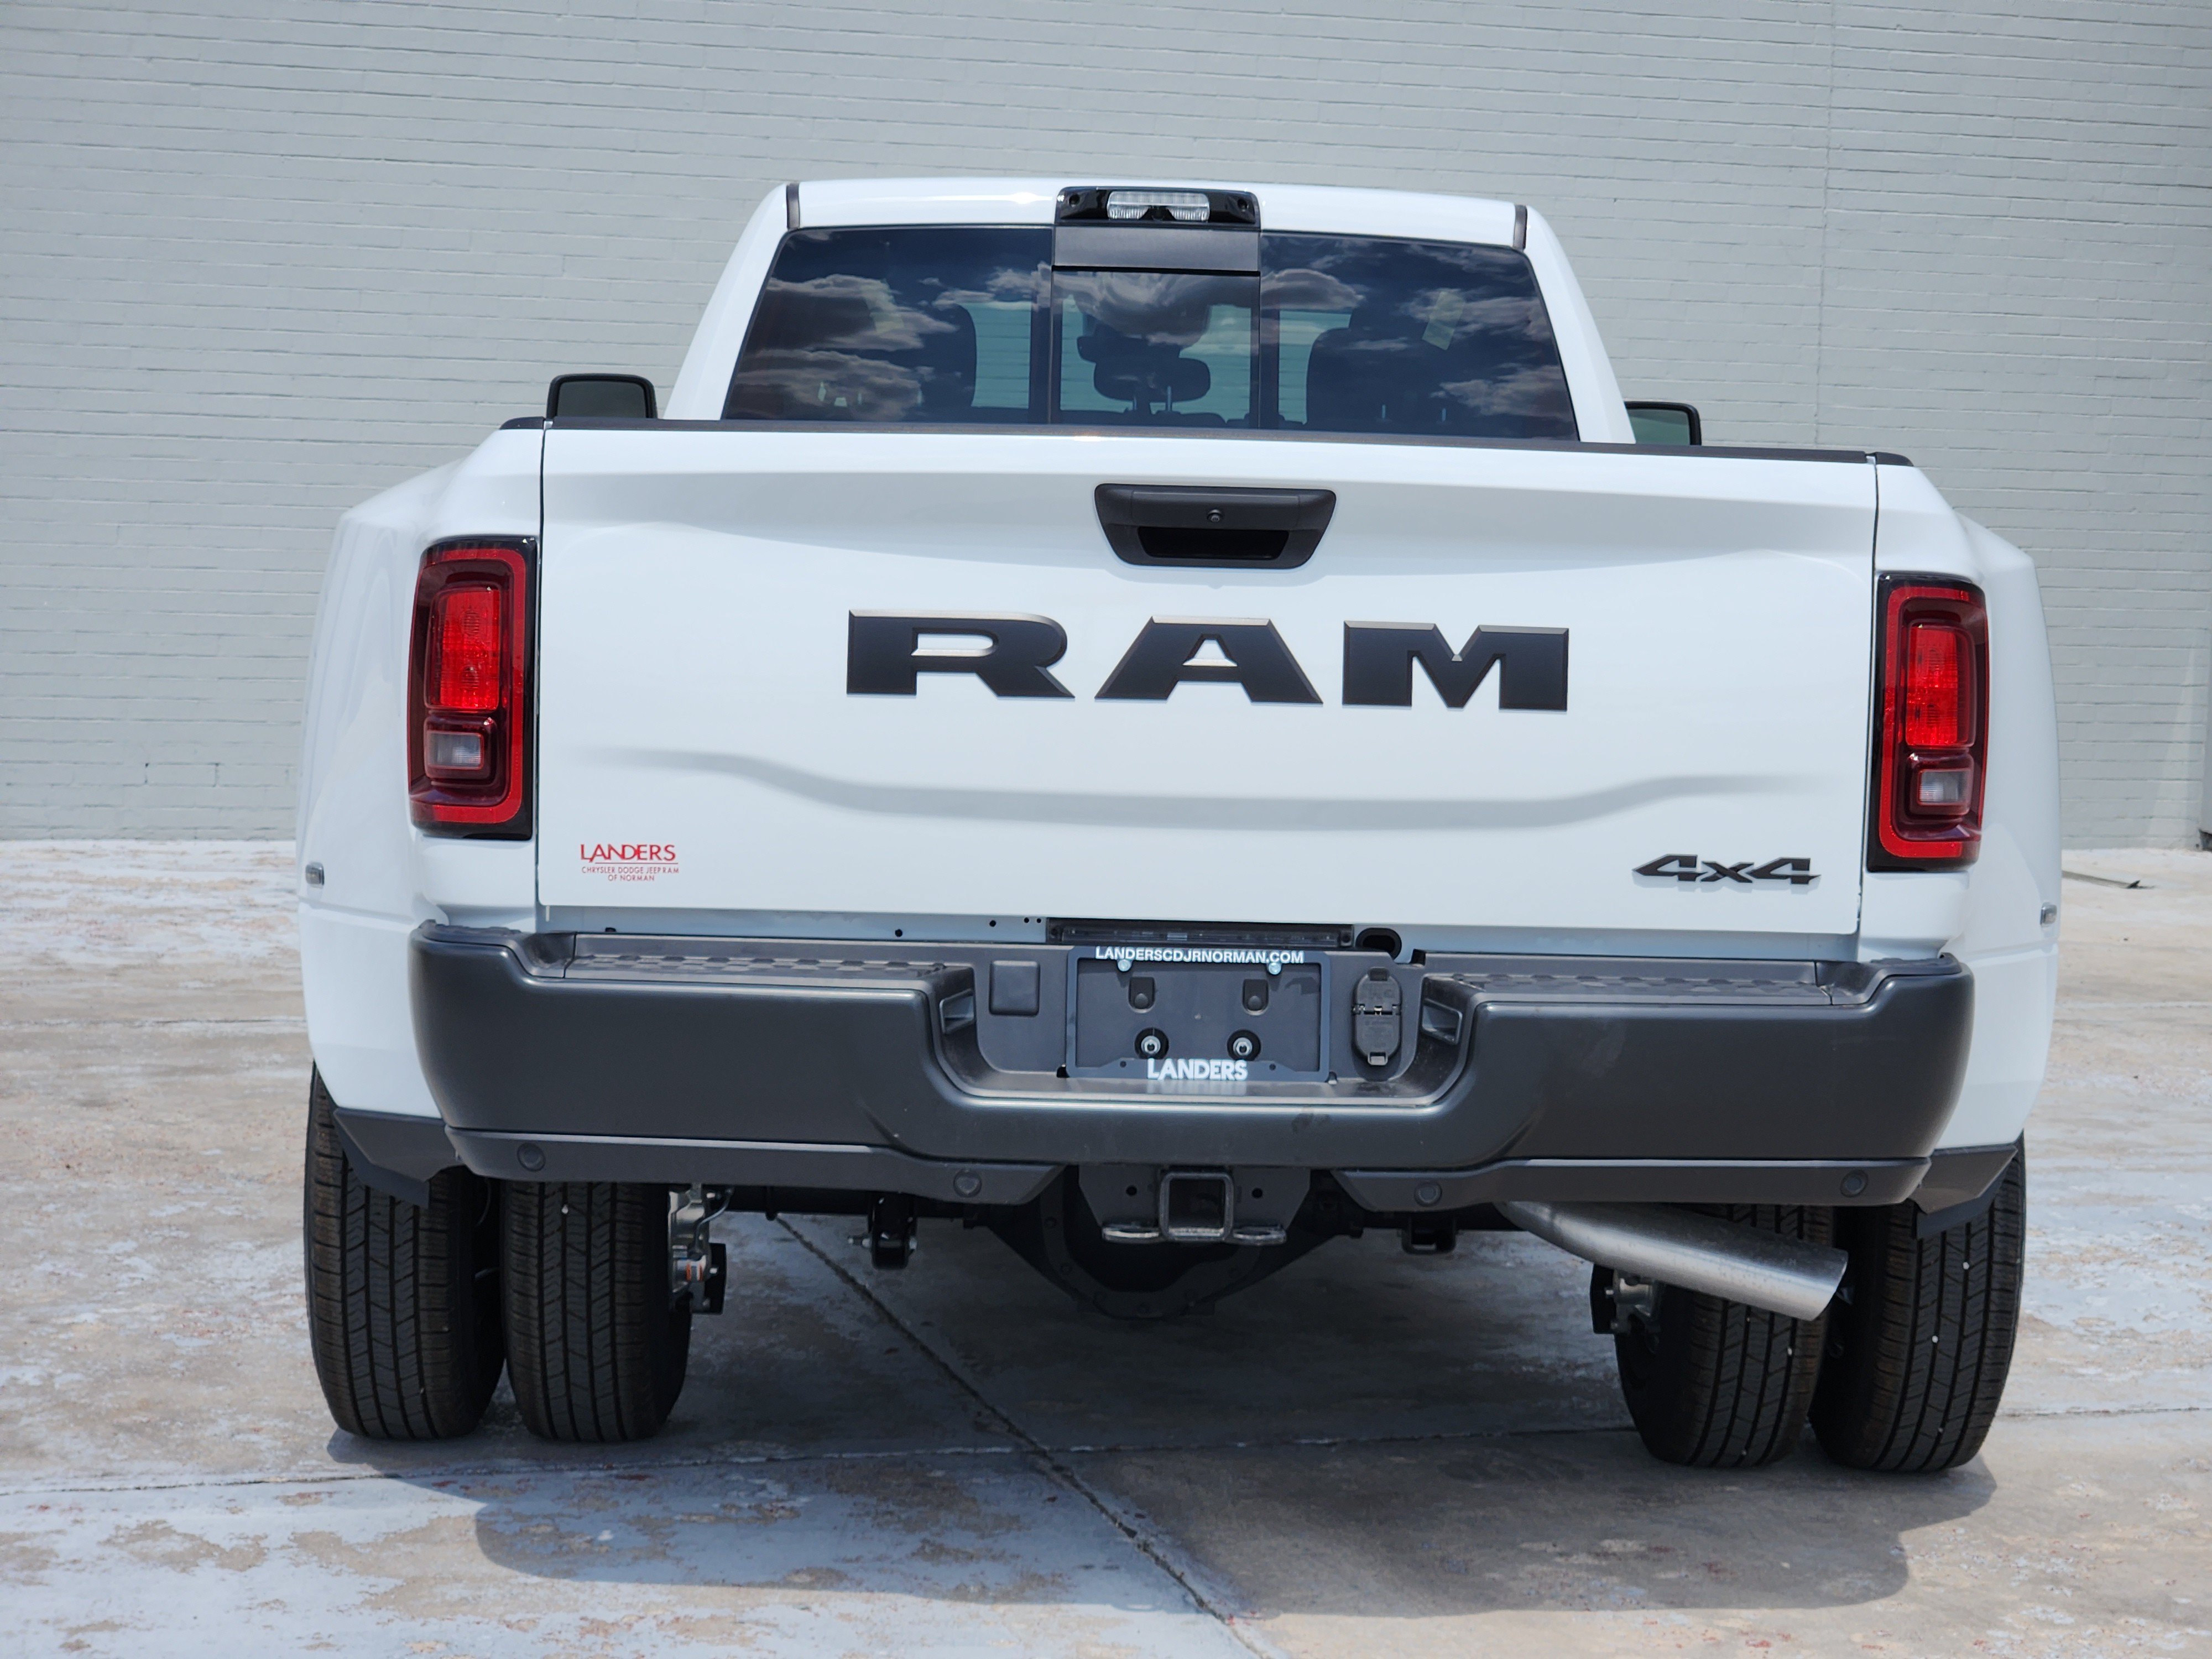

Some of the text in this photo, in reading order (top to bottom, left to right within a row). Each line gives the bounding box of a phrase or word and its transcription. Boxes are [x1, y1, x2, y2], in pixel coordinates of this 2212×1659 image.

[847, 609, 1569, 712] RAM
[581, 844, 676, 862] LANDERS
[1632, 854, 1821, 885] 4x4
[1095, 946, 1304, 964] LANDERSCDJRNORMAN.COM
[1147, 1058, 1248, 1081] LANDERS
